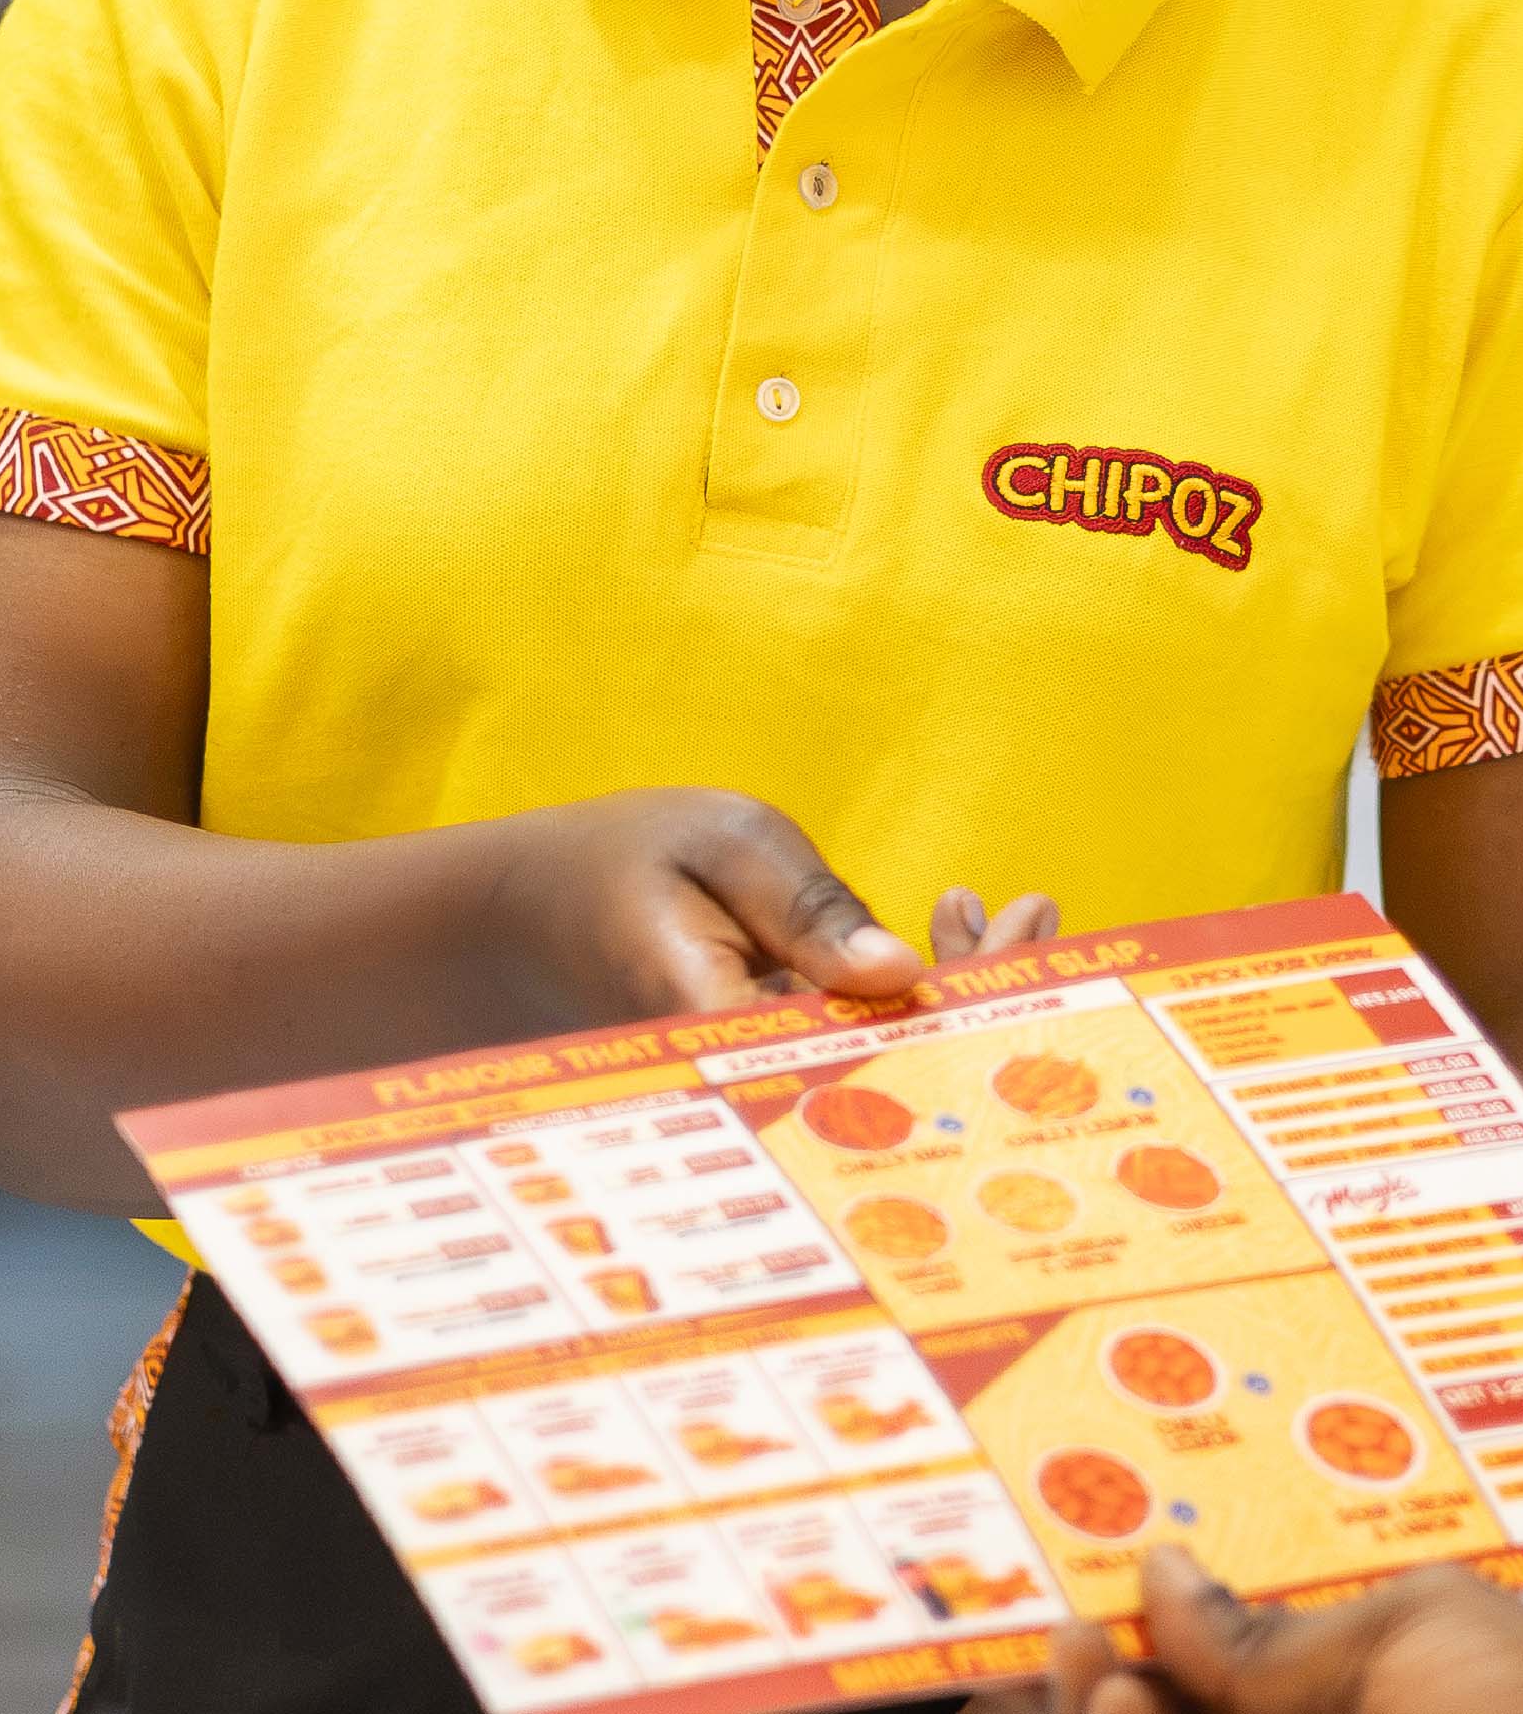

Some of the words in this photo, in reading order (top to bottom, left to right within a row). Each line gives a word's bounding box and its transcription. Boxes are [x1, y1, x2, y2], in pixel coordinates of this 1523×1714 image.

[996, 455, 1254, 558] CHIPOZ
[1248, 956, 1307, 978] YOUR
[373, 1053, 561, 1104] FLAVOUR
[558, 1034, 664, 1077] THAT
[670, 1009, 823, 1051] STICKS.
[942, 957, 1043, 997] THAT
[1047, 940, 1160, 976] SLAP.
[803, 1034, 870, 1061] YOUR
[958, 995, 1066, 1031] FLAVOUR
[951, 1629, 1054, 1677] FRES
